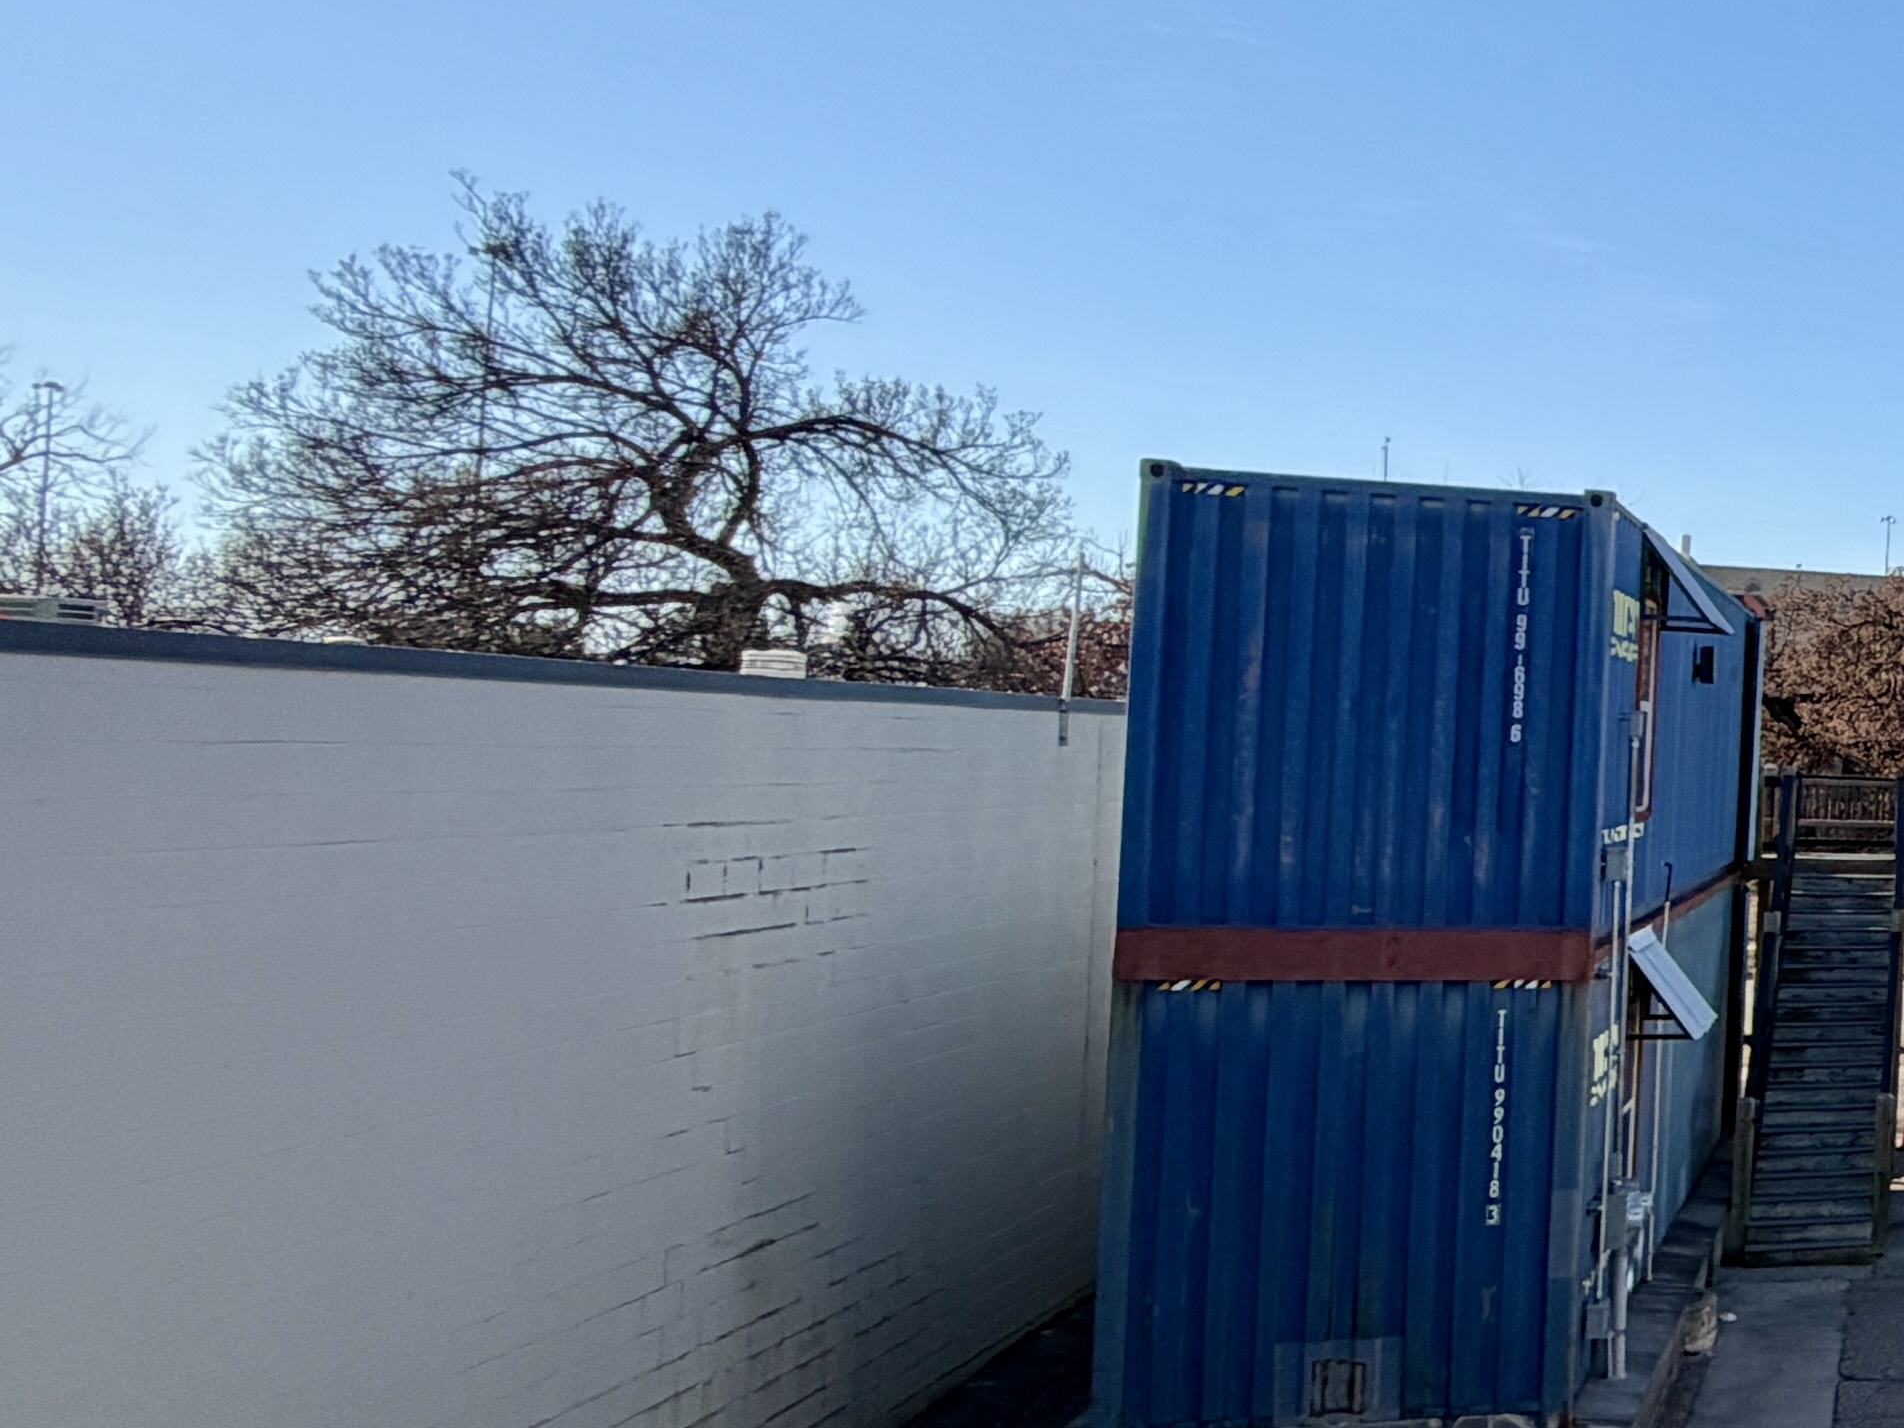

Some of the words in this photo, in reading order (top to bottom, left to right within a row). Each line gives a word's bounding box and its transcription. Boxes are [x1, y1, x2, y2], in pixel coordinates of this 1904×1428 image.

[1517, 535, 1533, 606] TITU
[1494, 1009, 1507, 1083] TITU
[1489, 1088, 1505, 1199] 990418
